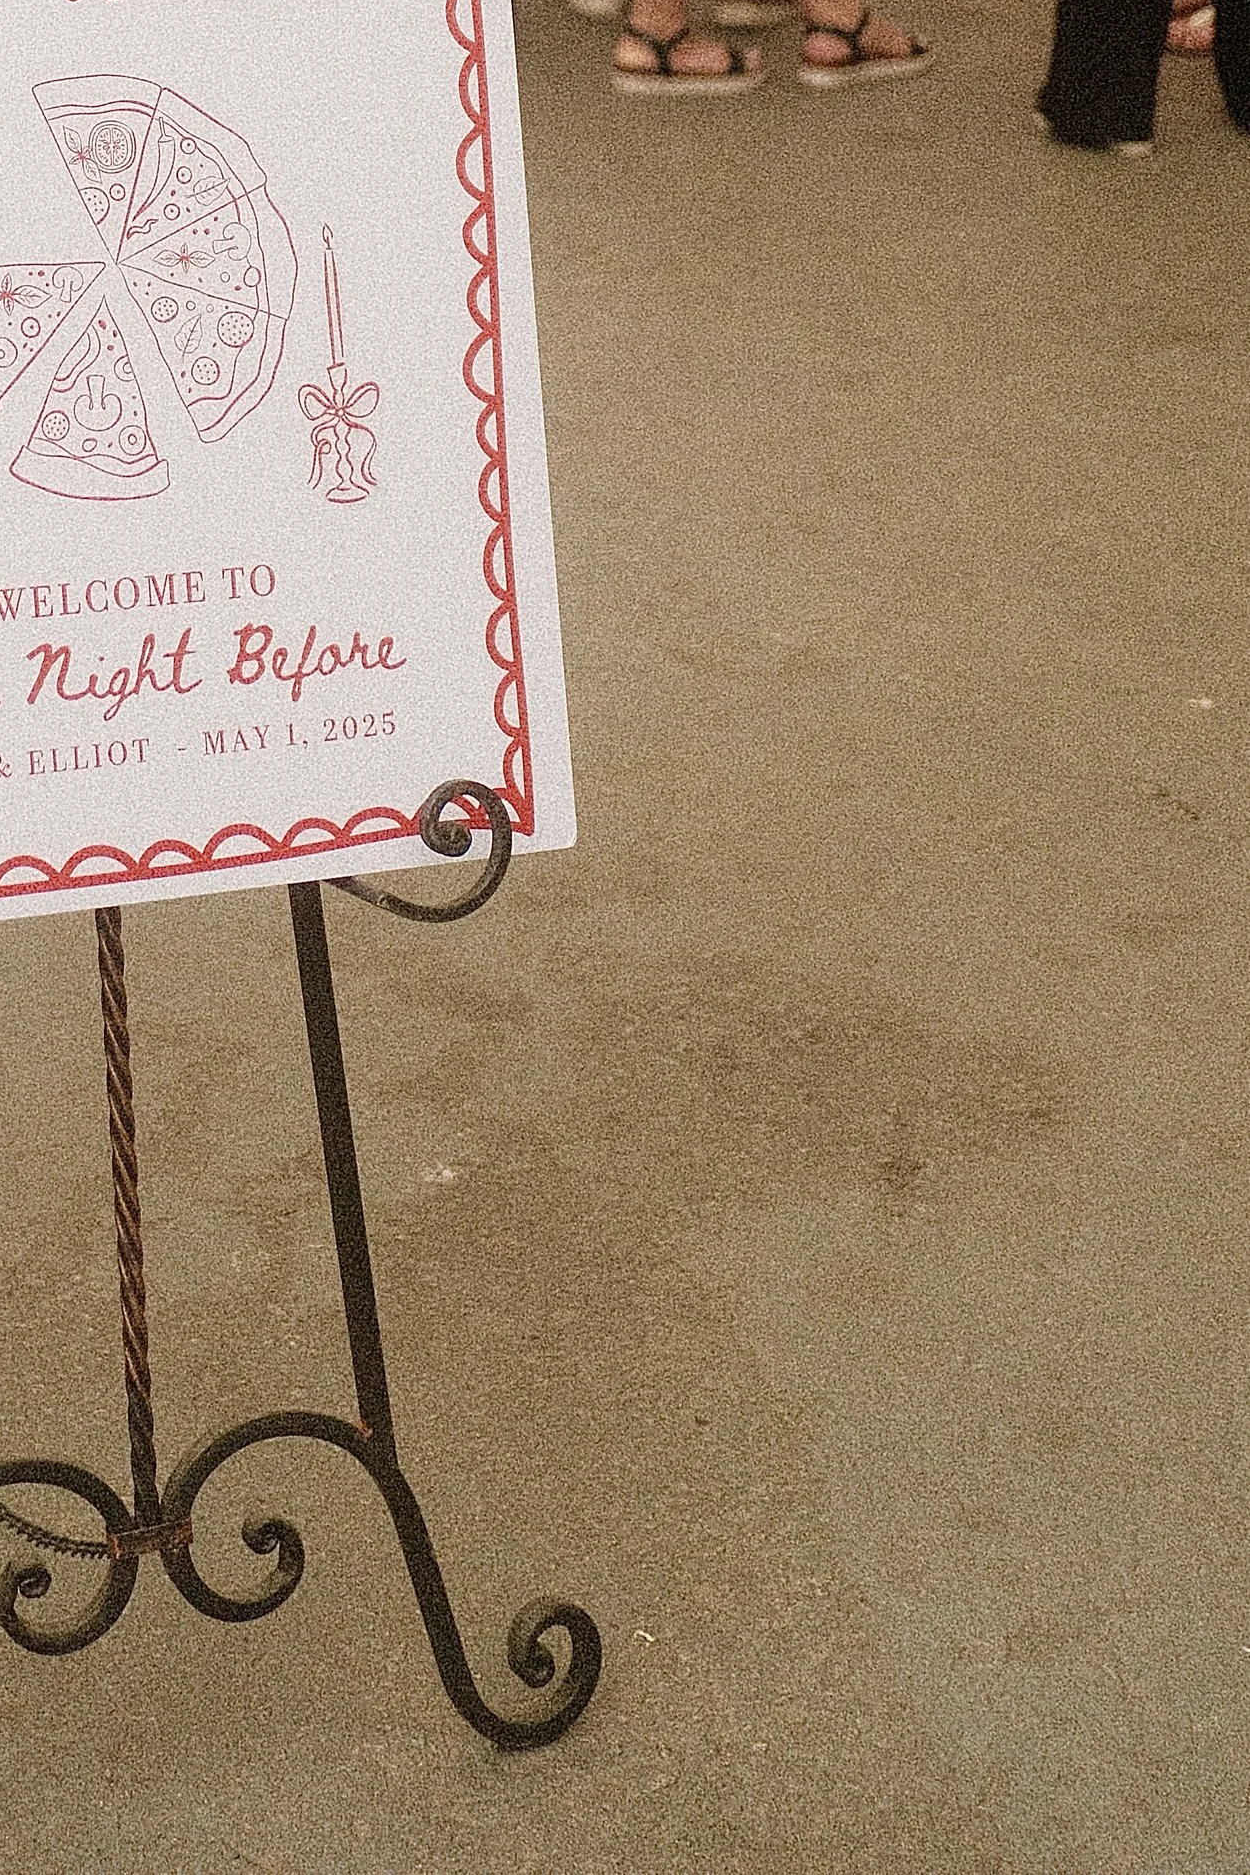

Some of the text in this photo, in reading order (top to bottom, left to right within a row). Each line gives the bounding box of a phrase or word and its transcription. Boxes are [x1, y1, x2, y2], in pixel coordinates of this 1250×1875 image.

[222, 564, 277, 599] TO
[25, 627, 203, 721] Night
[227, 622, 408, 702] Before
[28, 737, 151, 776] ELLIOT
[202, 722, 272, 757] MAY
[285, 722, 309, 751] 1,
[322, 710, 397, 744] 2025
